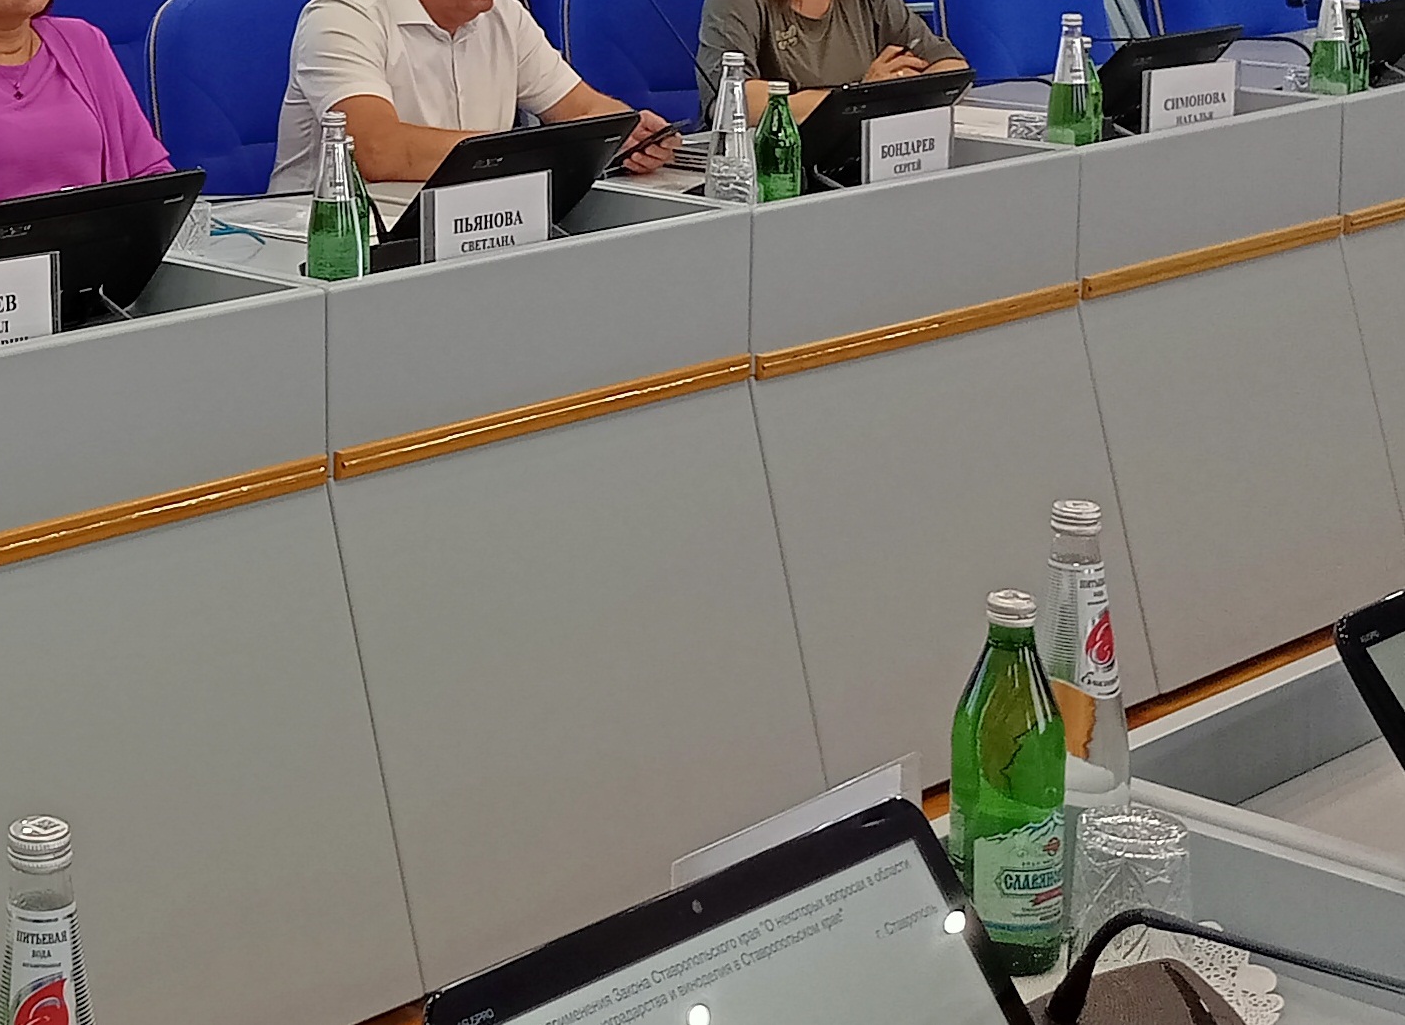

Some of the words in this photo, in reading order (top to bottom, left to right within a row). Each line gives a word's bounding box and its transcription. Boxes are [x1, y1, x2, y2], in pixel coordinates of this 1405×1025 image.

[1163, 91, 1227, 112] СИМОНОВА
[880, 137, 936, 160] БОНДАРЕВ
[893, 158, 922, 174] СЕРГЕЙ
[453, 209, 524, 235] ПЬЯНОВА
[460, 234, 516, 253] СВЕТЛАНА
[16, 929, 68, 945] ПИТЬЕВАЯ
[31, 949, 52, 959] ВОДА
[612, 977, 652, 1002] Закона
[650, 936, 738, 986] Ставропольского
